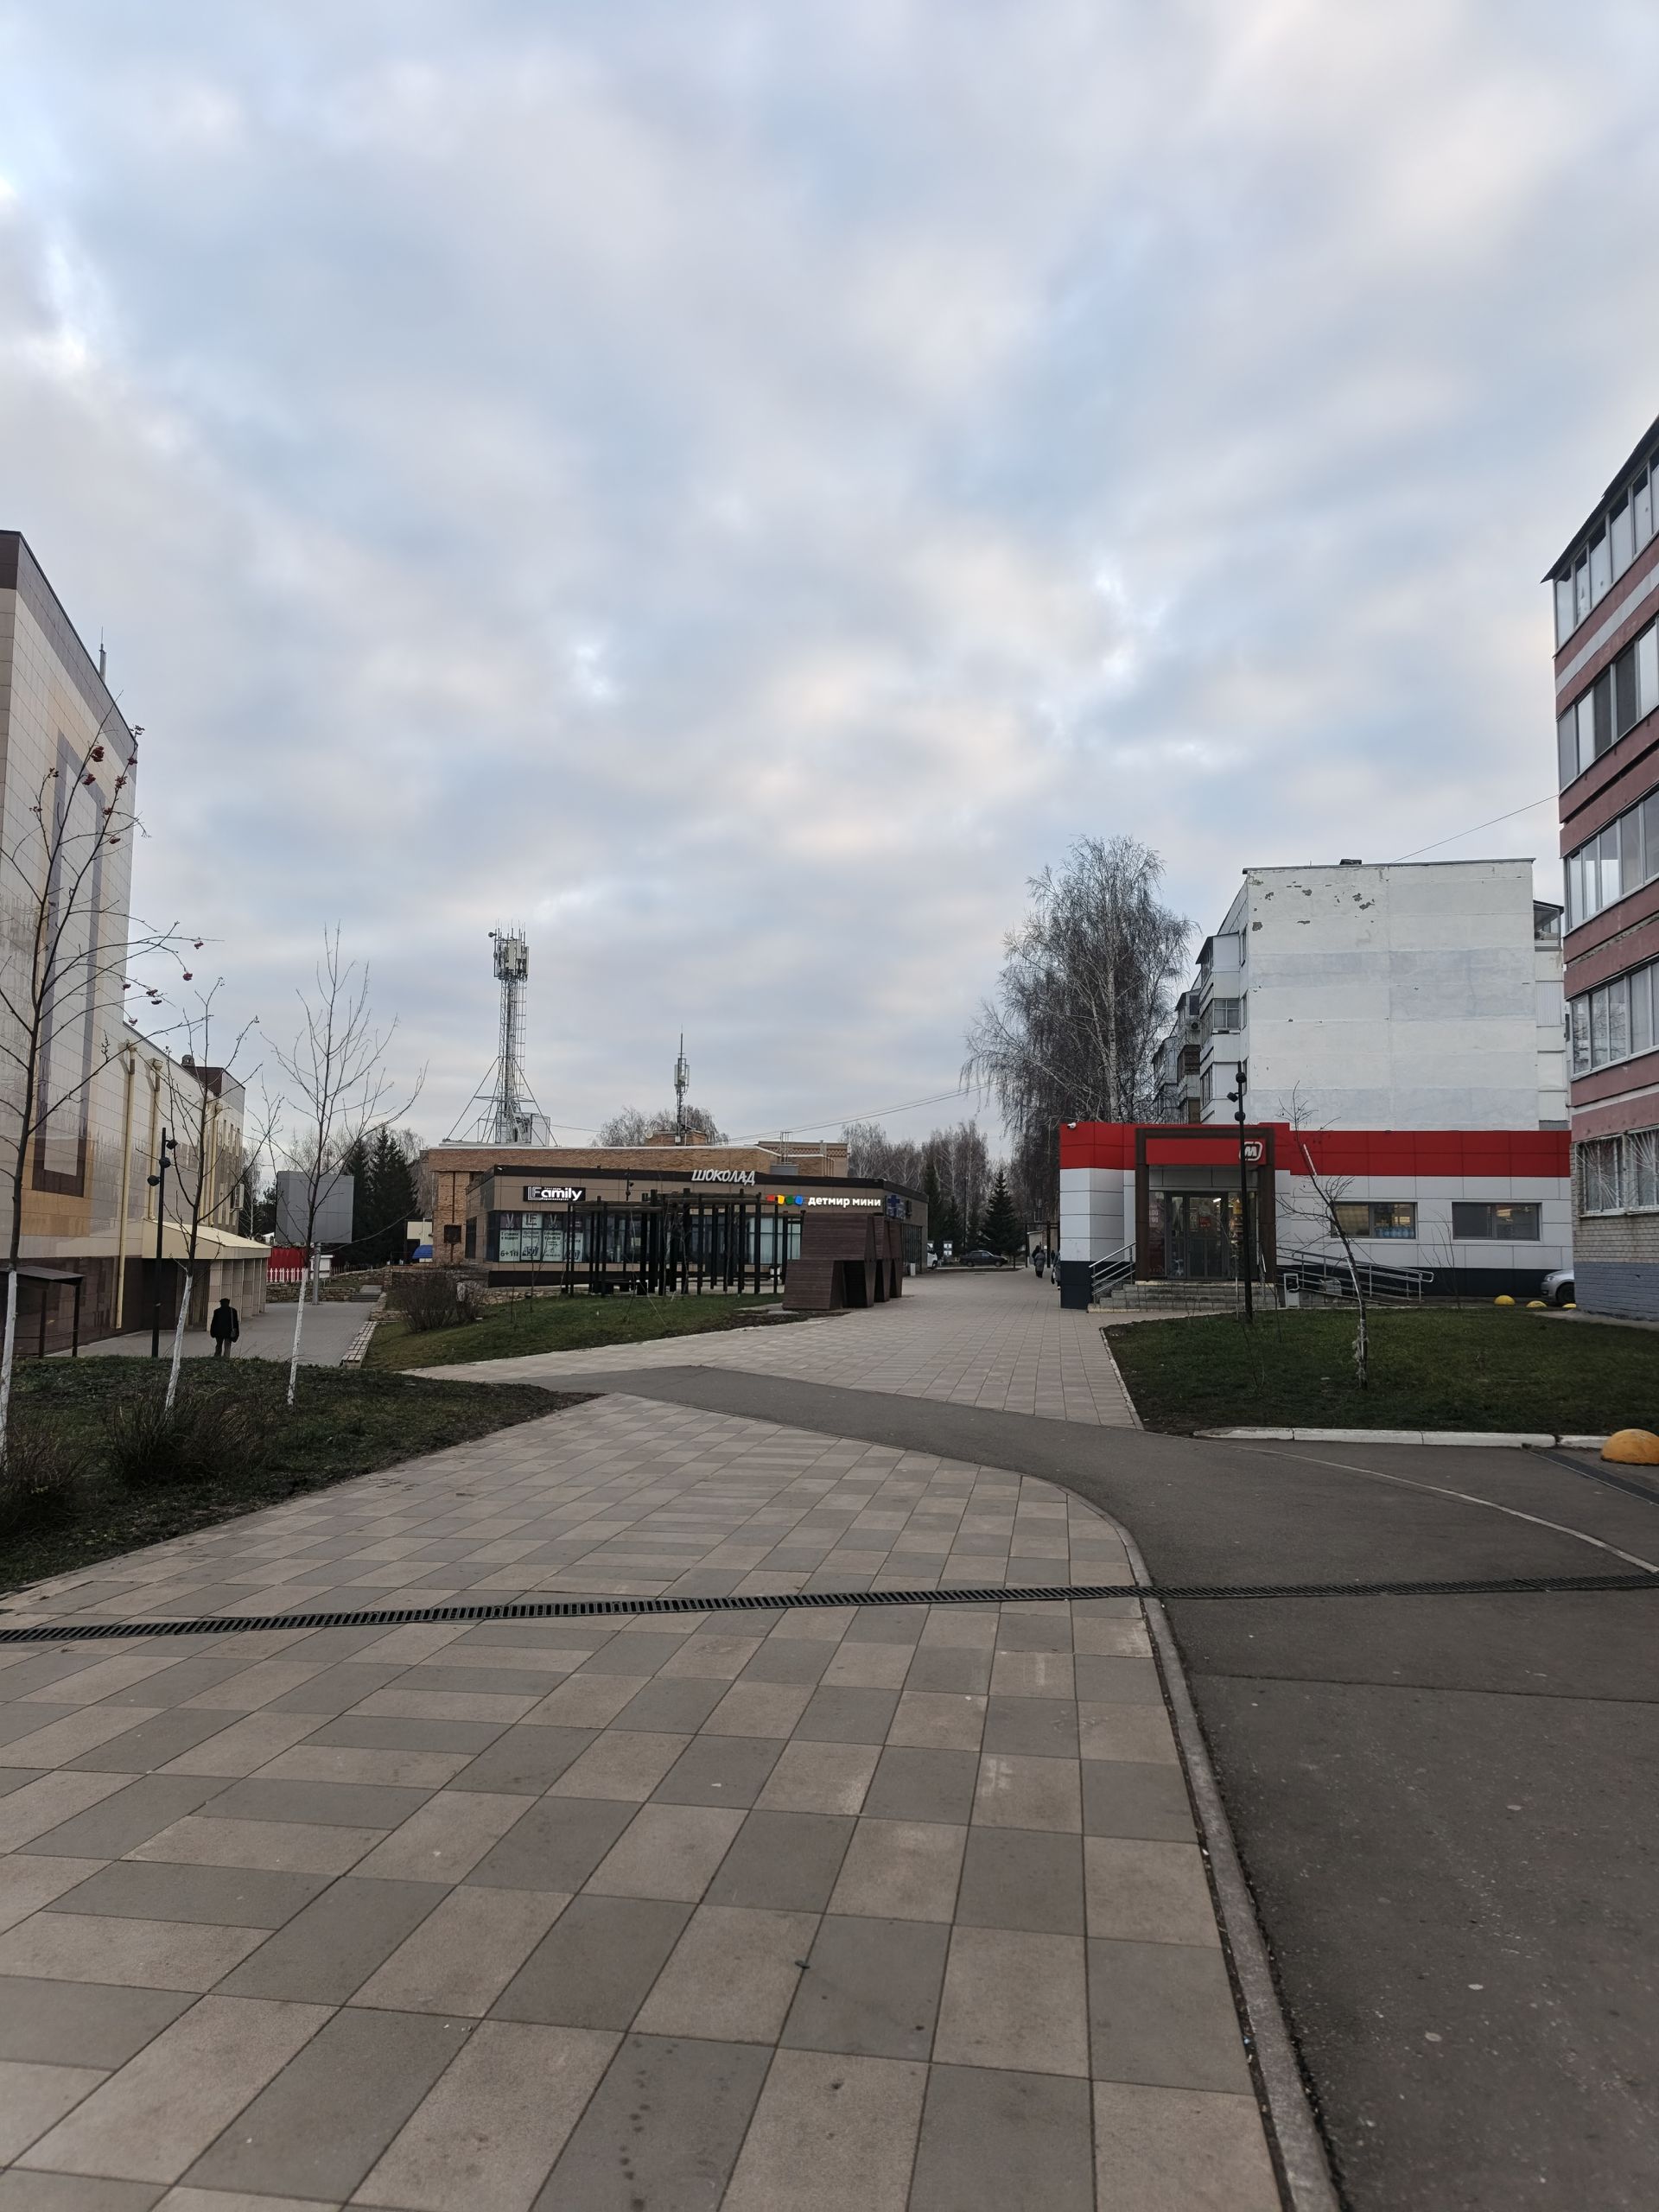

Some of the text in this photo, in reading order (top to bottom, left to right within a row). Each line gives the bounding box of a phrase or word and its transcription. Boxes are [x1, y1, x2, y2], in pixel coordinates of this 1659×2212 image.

[691, 1168, 755, 1186] ШОКОЛАД
[808, 1197, 881, 1208] детмир мини
